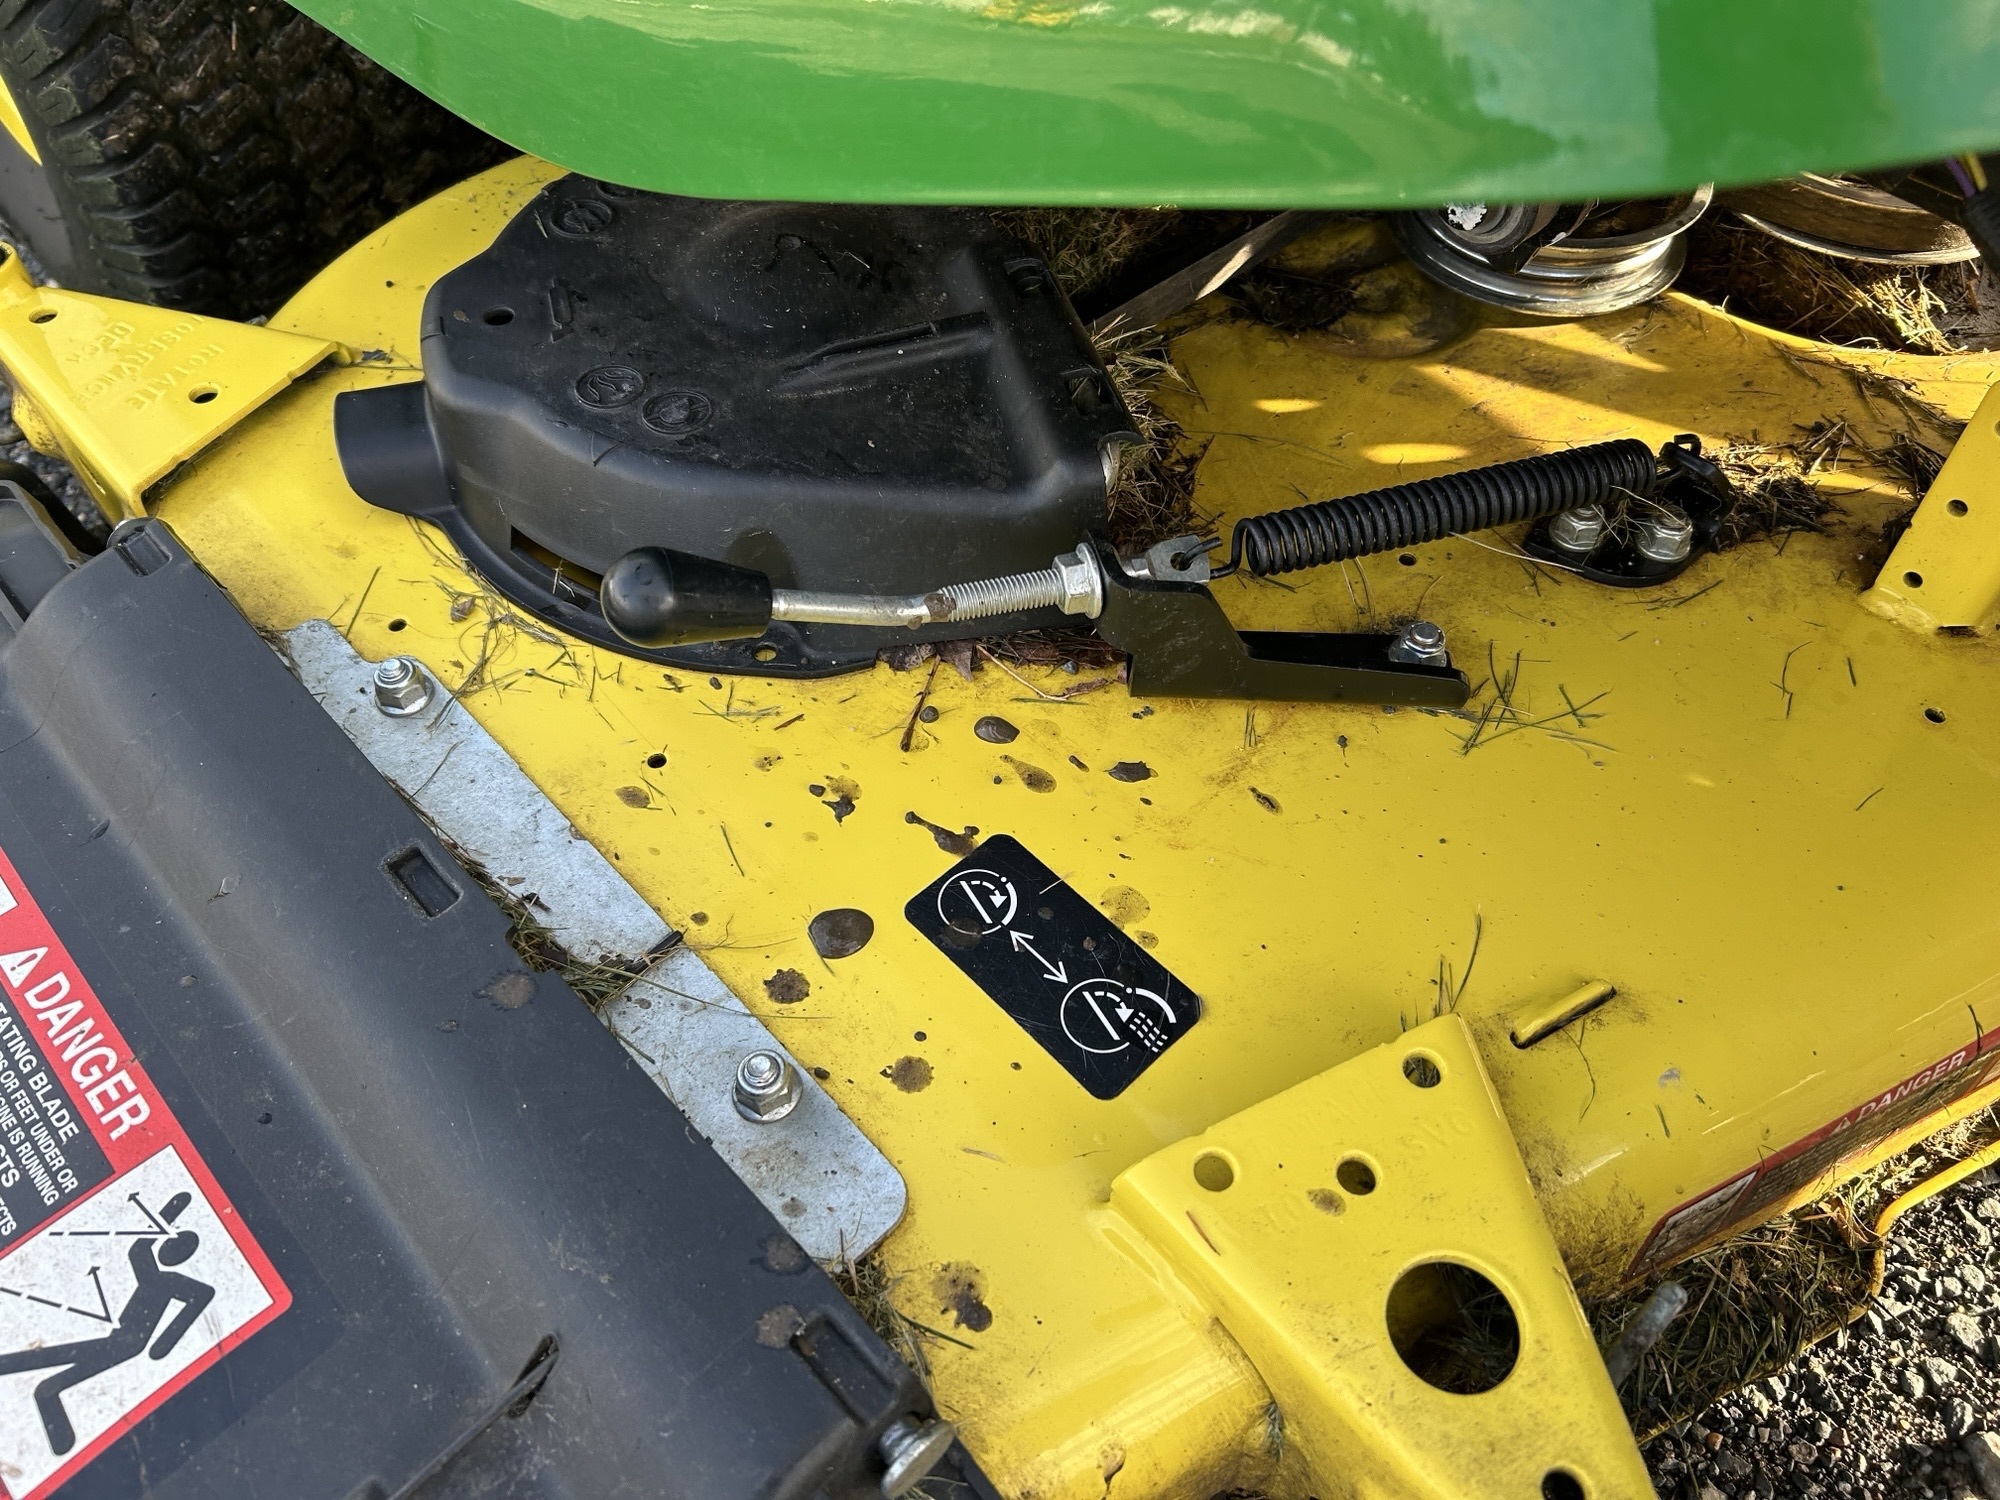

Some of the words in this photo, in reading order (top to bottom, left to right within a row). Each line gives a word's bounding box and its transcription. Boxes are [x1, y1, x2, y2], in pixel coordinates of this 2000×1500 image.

[24, 971, 151, 1141] DANGER
[1853, 1050, 1967, 1124] DANGER
[0, 1070, 20, 1093] OR
[10, 1089, 40, 1124] FEET
[30, 1121, 64, 1172] UNDER
[56, 1167, 79, 1194] OR
[28, 1072, 79, 1142] BLADE
[7, 1126, 25, 1146] IS
[16, 1141, 60, 1206] RUNNING
